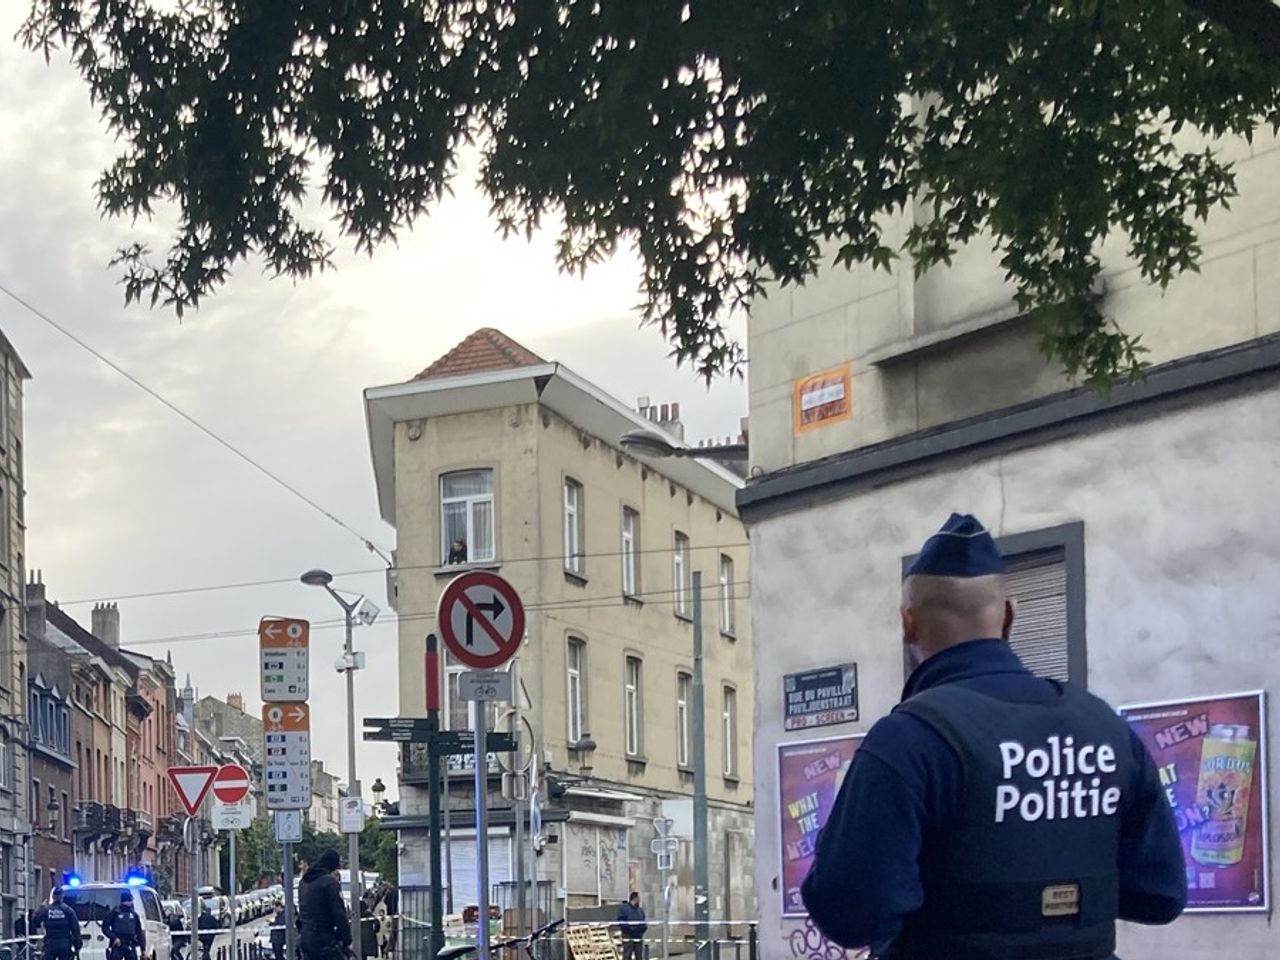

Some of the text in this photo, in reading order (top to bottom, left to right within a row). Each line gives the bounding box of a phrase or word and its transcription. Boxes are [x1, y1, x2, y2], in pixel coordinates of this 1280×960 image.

[1155, 713, 1209, 750] NEW
[804, 752, 840, 779] NEW
[999, 735, 1117, 779] Police
[1158, 763, 1177, 786] AT
[788, 792, 819, 819] WHAT
[994, 778, 1121, 822] Politie
[798, 812, 820, 834] THE
